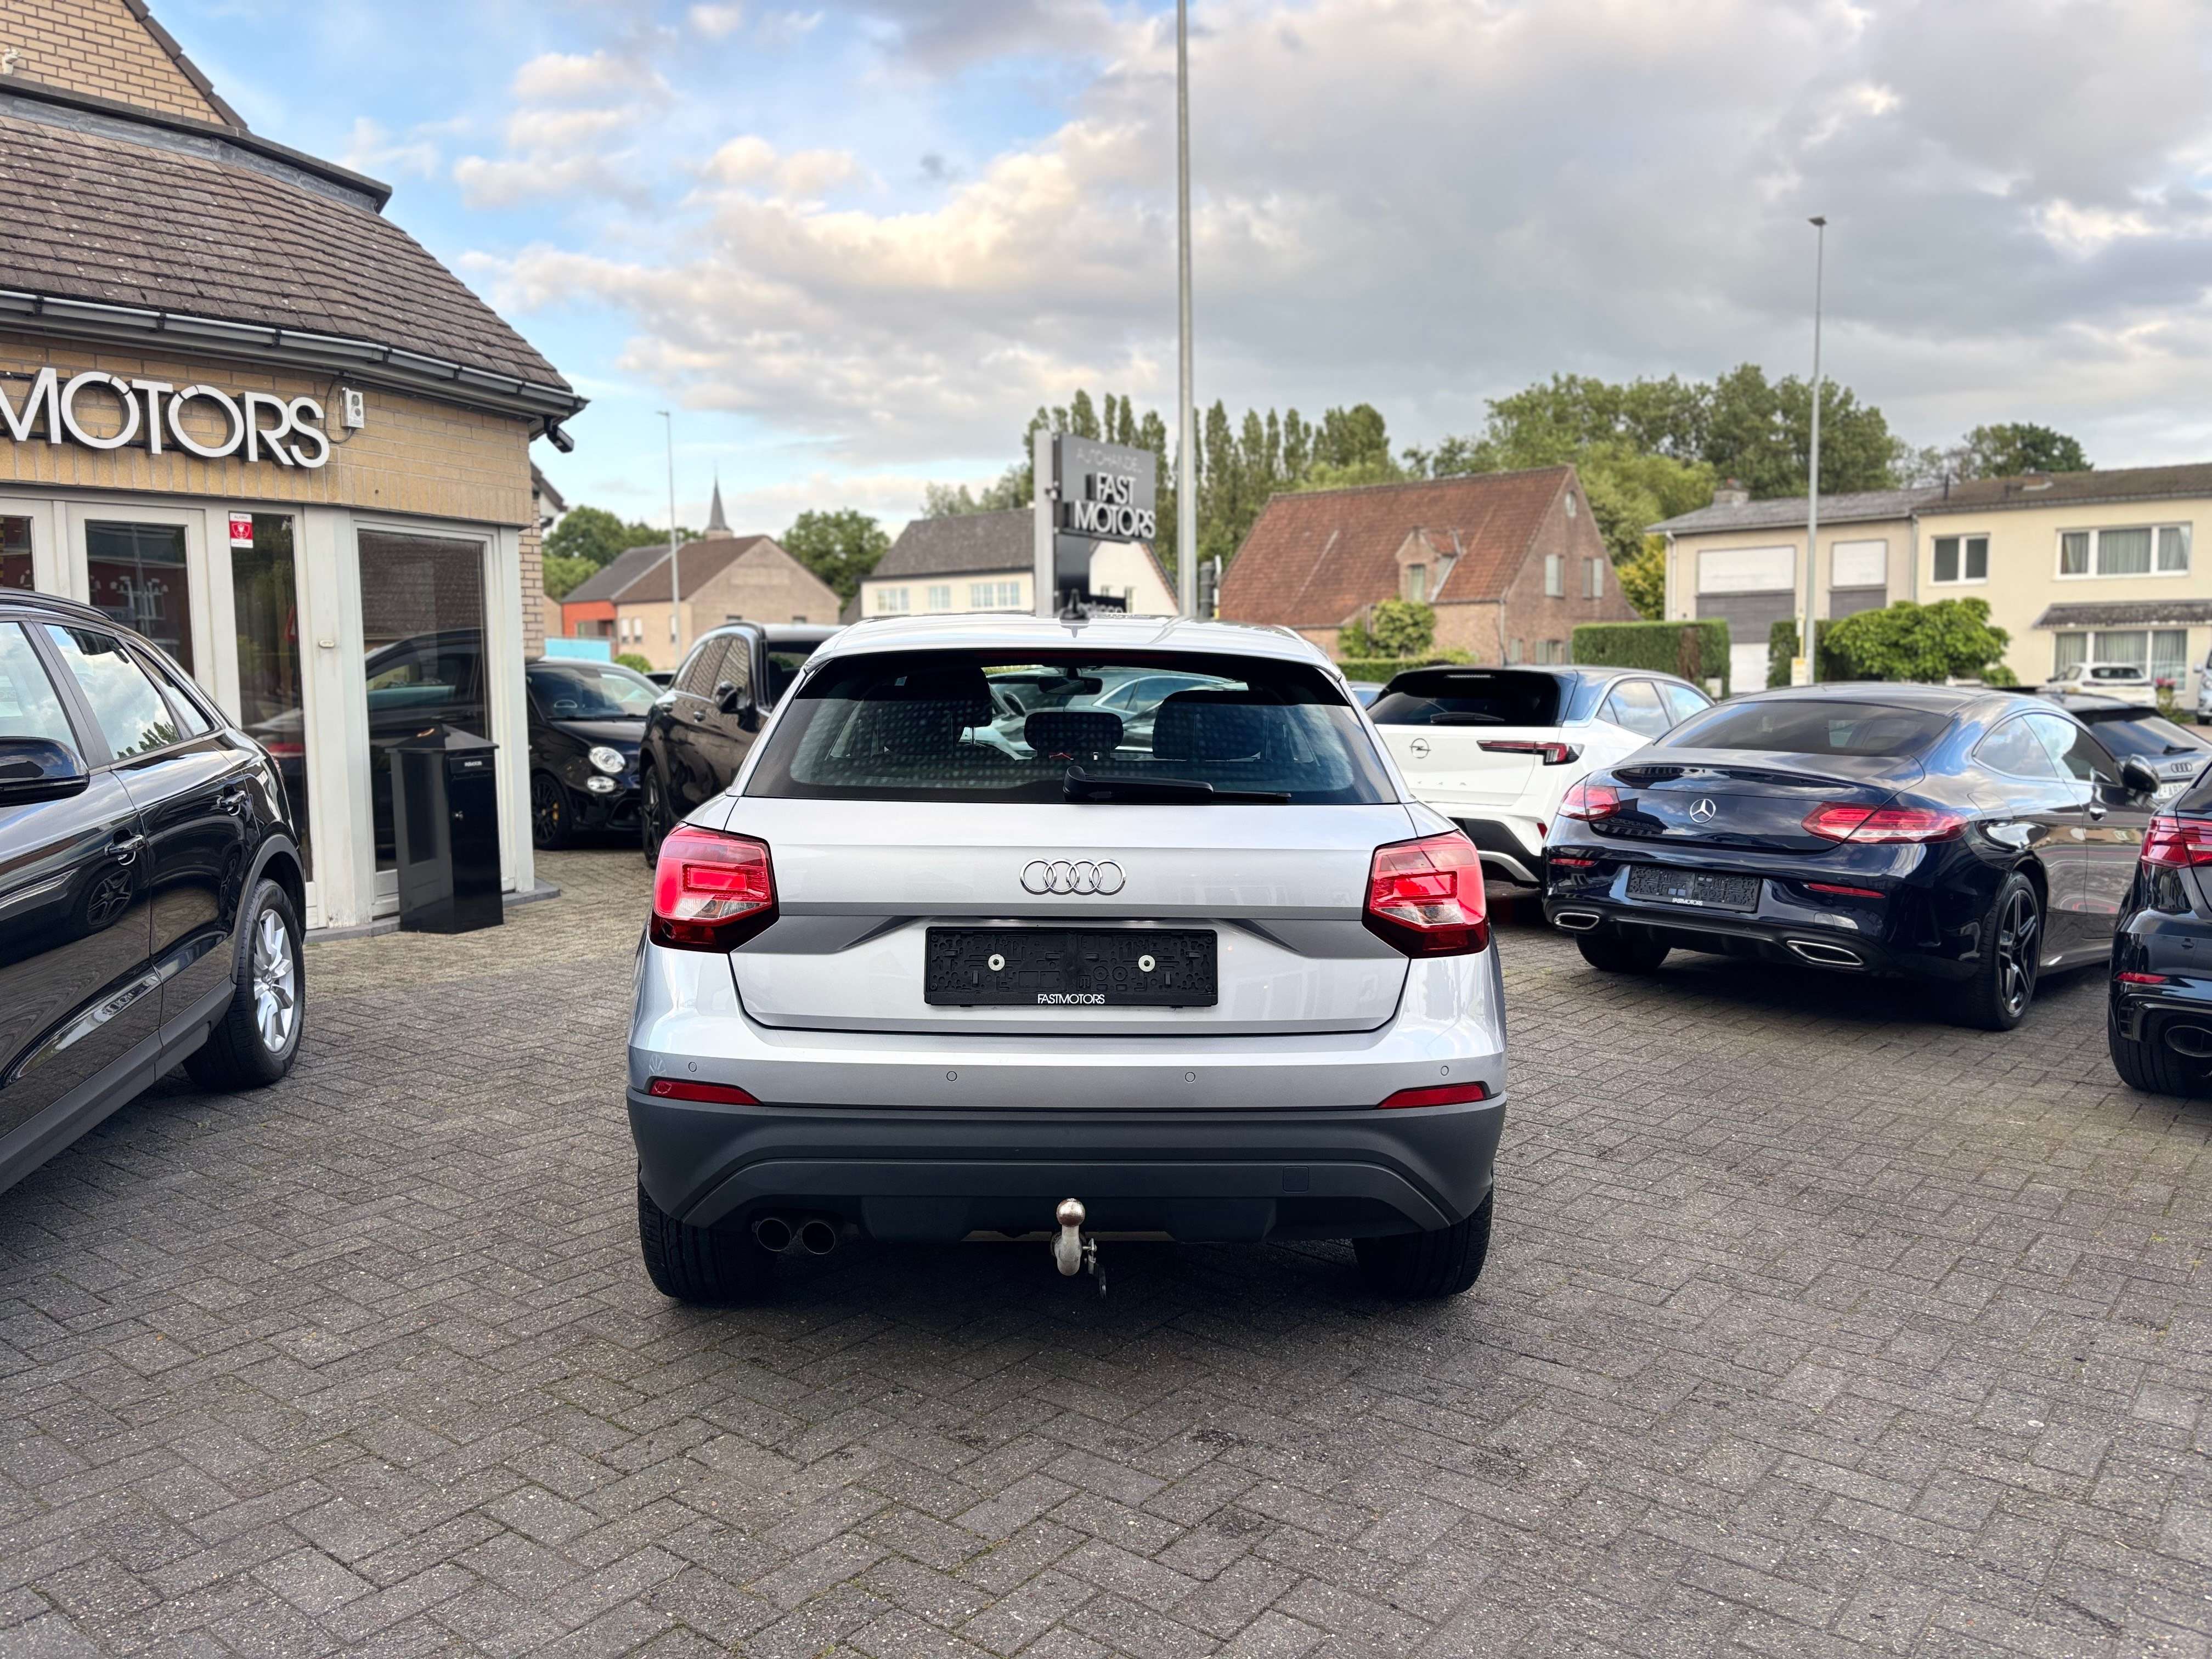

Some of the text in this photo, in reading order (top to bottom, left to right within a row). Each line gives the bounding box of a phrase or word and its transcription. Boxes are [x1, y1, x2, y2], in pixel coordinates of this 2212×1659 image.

[0, 367, 330, 468] MOTORS
[1097, 472, 1136, 505] FAST
[1074, 500, 1156, 539] MOTORS
[1672, 898, 1703, 906] FASTMOTORS
[1037, 994, 1105, 1004] FASTMOTORS
